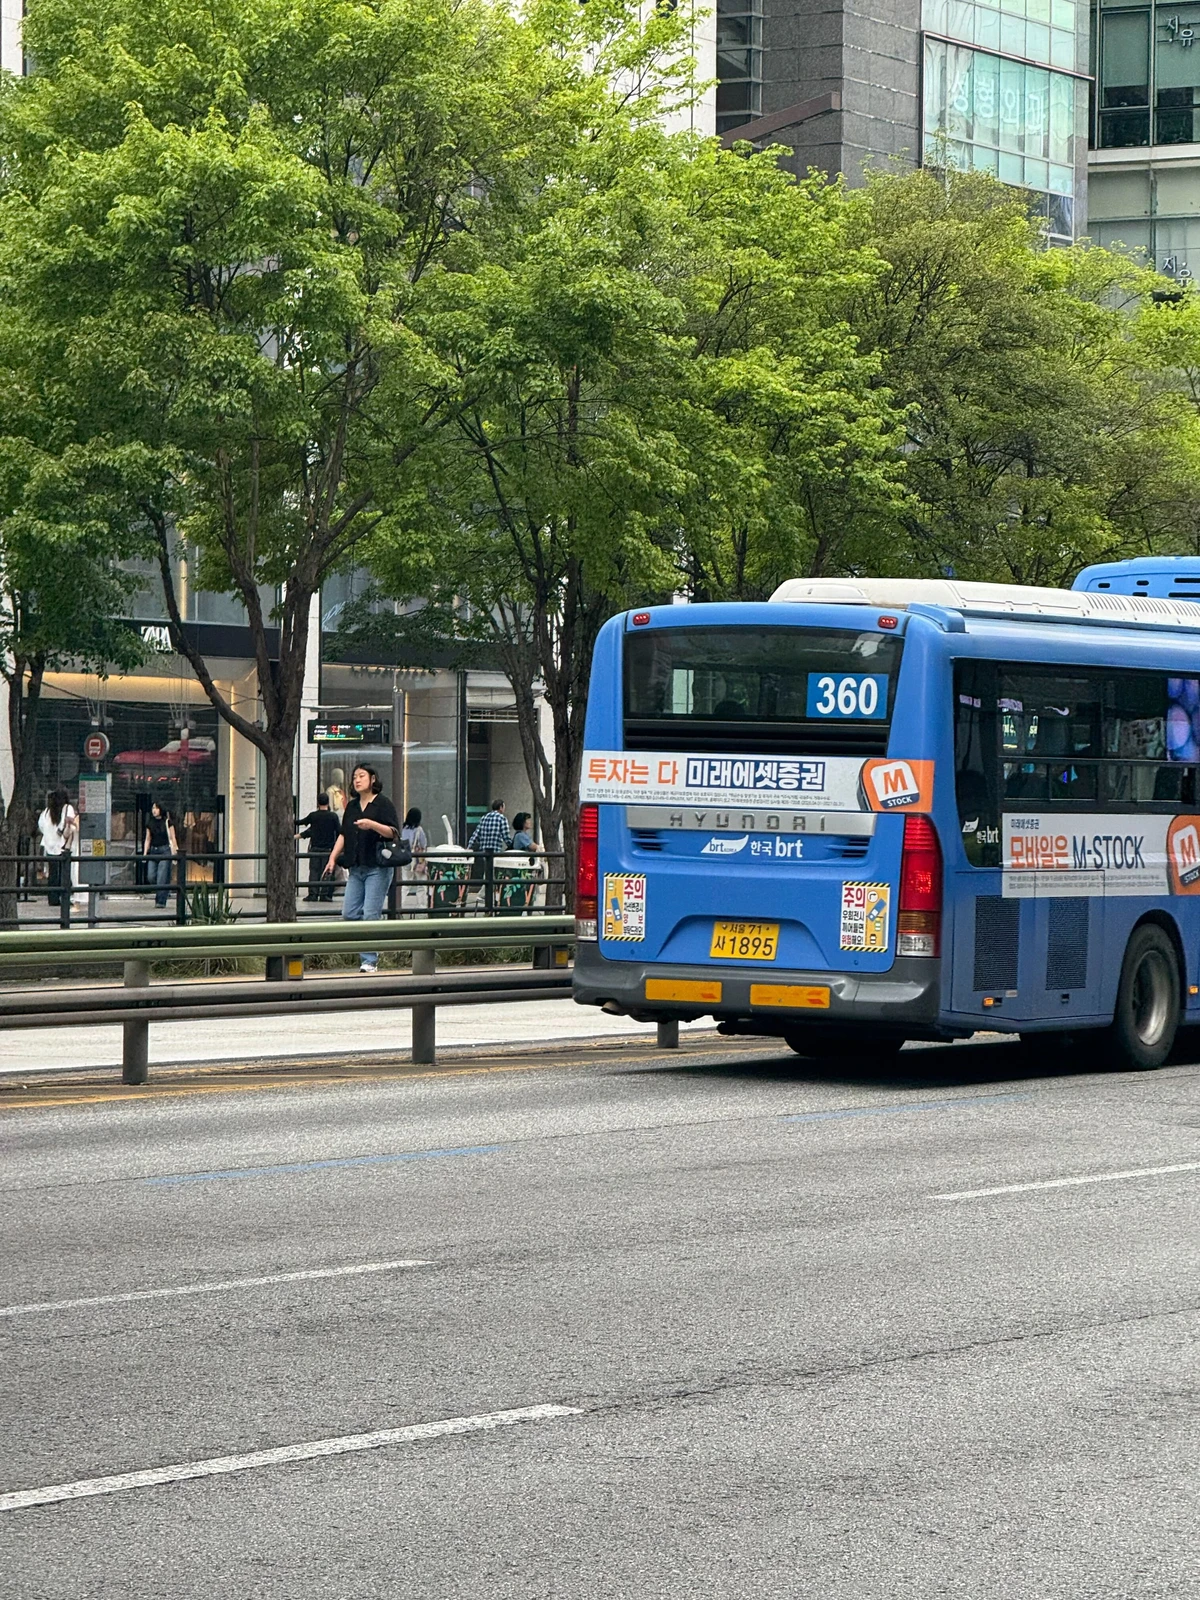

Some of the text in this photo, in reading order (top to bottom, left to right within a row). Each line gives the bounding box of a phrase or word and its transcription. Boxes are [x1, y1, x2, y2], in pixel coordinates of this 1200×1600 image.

[141, 625, 173, 651] ZARA
[816, 676, 879, 715] 360
[588, 758, 824, 790] 투자는 다 미래에셋증권
[883, 768, 908, 795] M
[887, 796, 913, 807] STOCK
[670, 811, 826, 832] HYUNDAI
[987, 825, 999, 844] brt
[709, 841, 724, 852] brt
[751, 836, 803, 858] 한국 brt
[1010, 835, 1145, 870] 모바일은 M-STOCK
[1180, 834, 1197, 868] M
[624, 879, 644, 900] 주의
[844, 887, 866, 909] 주의
[730, 923, 762, 935] 서울 71
[714, 935, 774, 956] 사 1895
